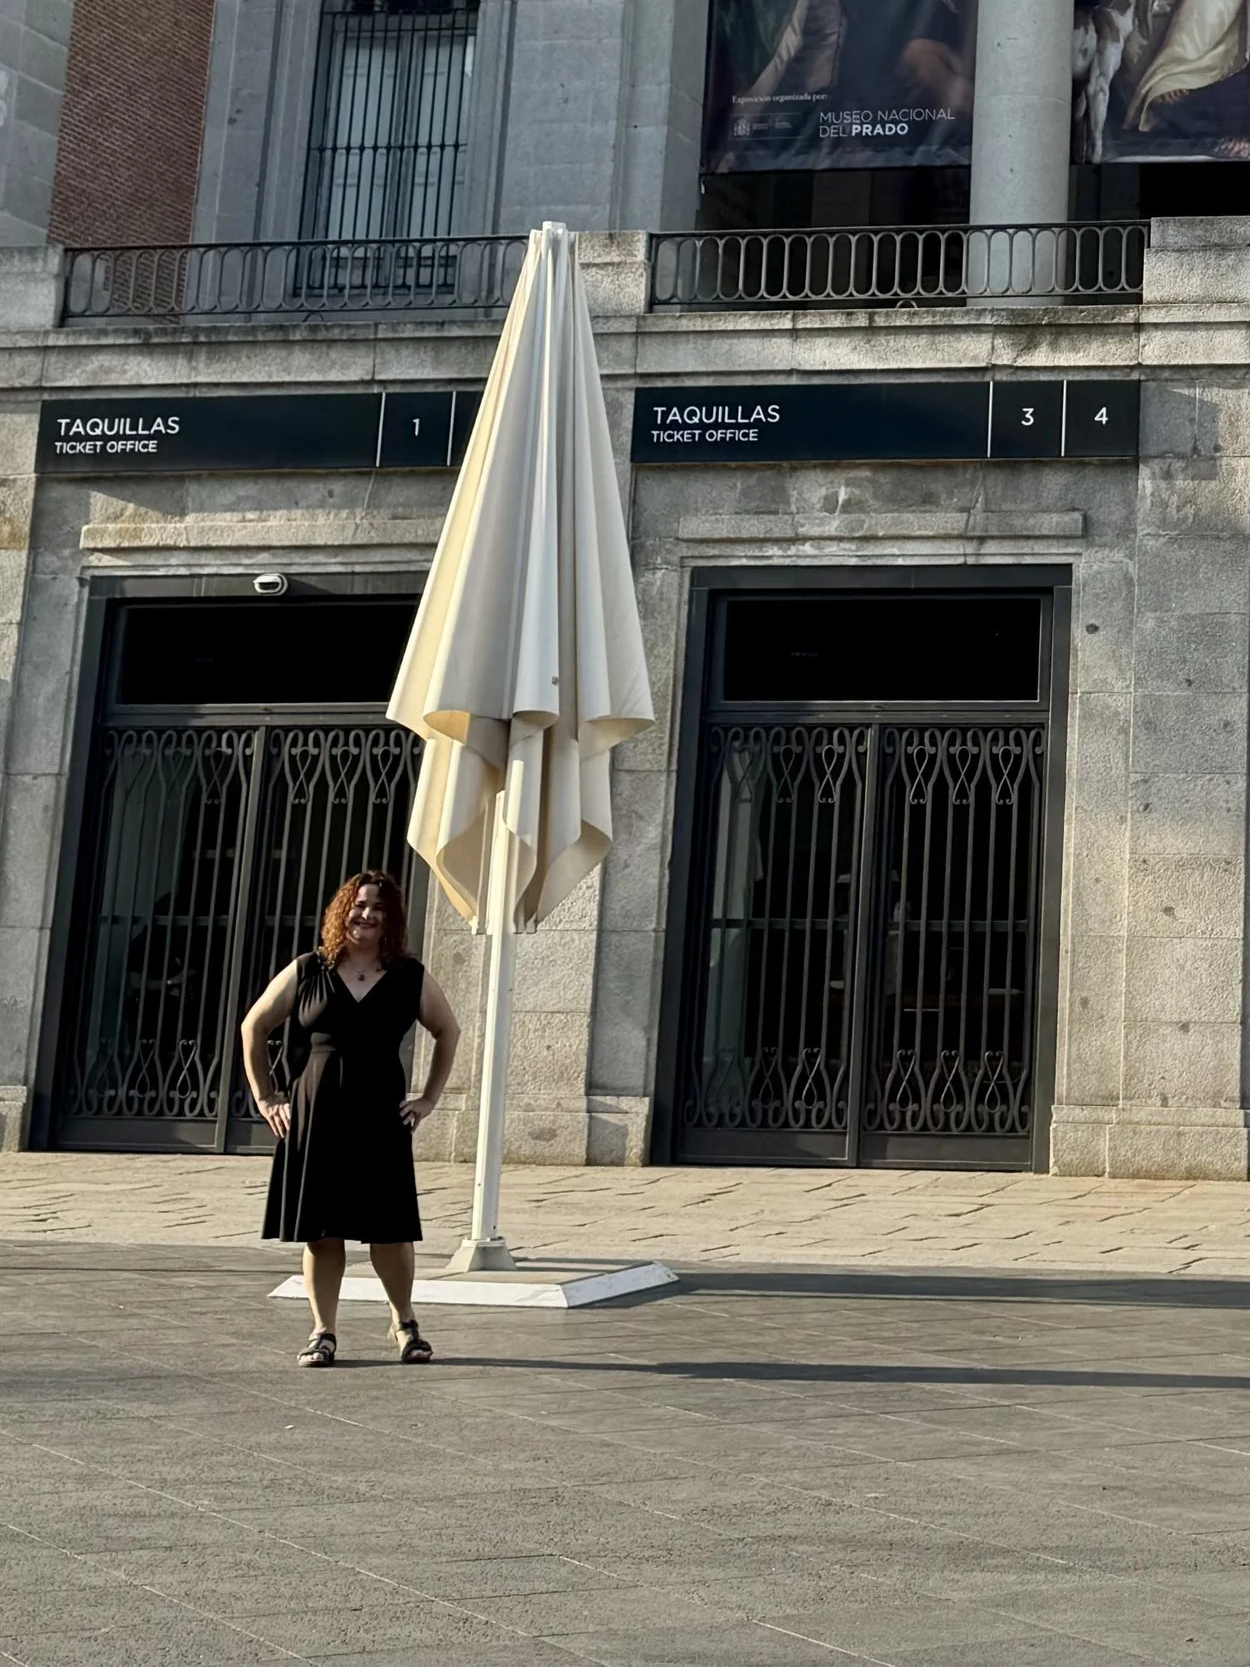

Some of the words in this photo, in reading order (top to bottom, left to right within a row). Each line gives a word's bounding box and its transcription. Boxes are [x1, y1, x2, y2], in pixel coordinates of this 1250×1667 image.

[820, 110, 873, 124] MUSEO
[877, 107, 956, 122] NACIONAL
[819, 125, 848, 138] DEL
[852, 123, 909, 137] PRADO
[653, 405, 780, 424] TAQUILLAS
[1021, 408, 1035, 426] 3
[1094, 406, 1109, 425] 4
[57, 416, 180, 436] TAQUILLAS
[412, 418, 420, 437] 1
[651, 430, 702, 443] TICKET
[705, 429, 759, 442] OFFICE
[54, 441, 104, 454] TICKET
[106, 440, 158, 453] OFFICE
